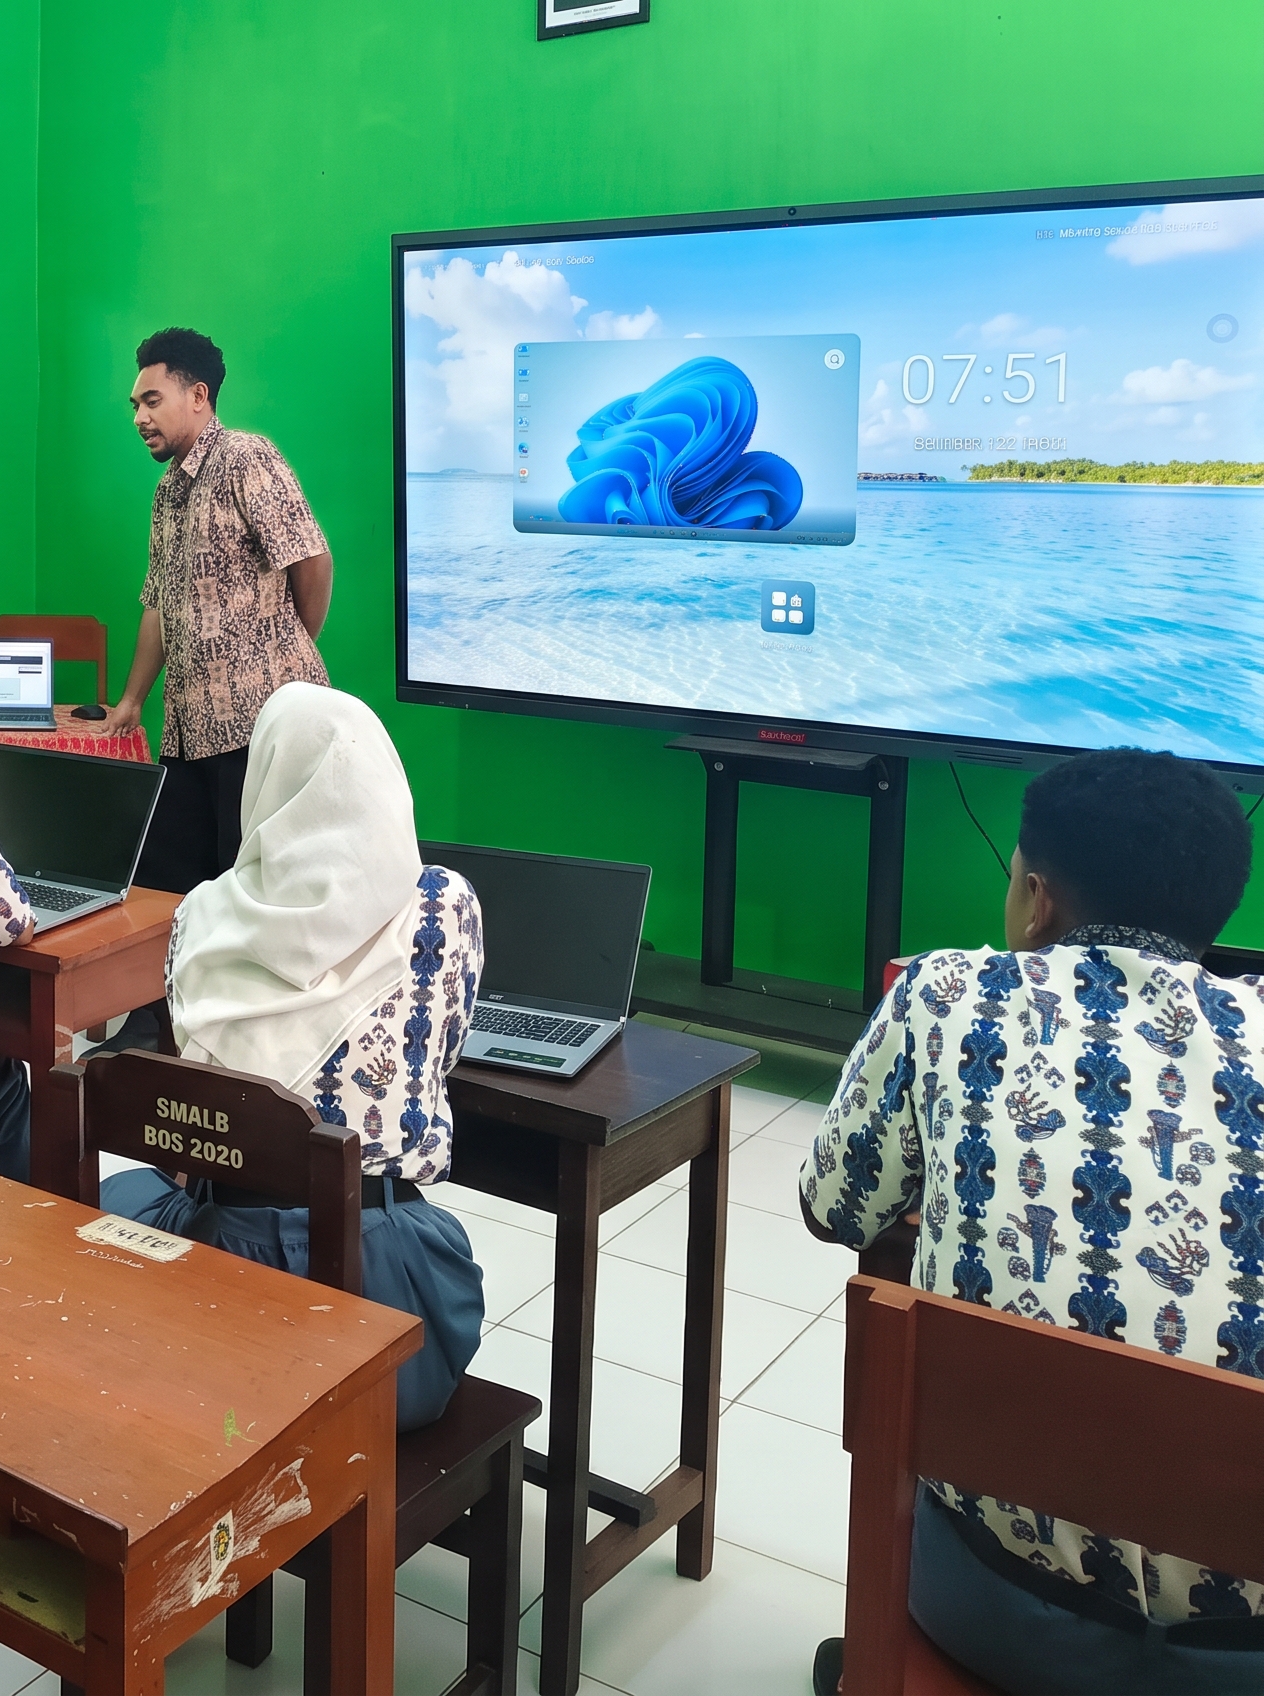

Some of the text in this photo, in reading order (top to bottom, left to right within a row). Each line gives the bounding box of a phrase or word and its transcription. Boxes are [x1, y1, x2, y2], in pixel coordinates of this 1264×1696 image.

[902, 352, 1067, 405] 07:51
[156, 1097, 230, 1134] SMALB
[144, 1124, 244, 1169] BOS 2020
